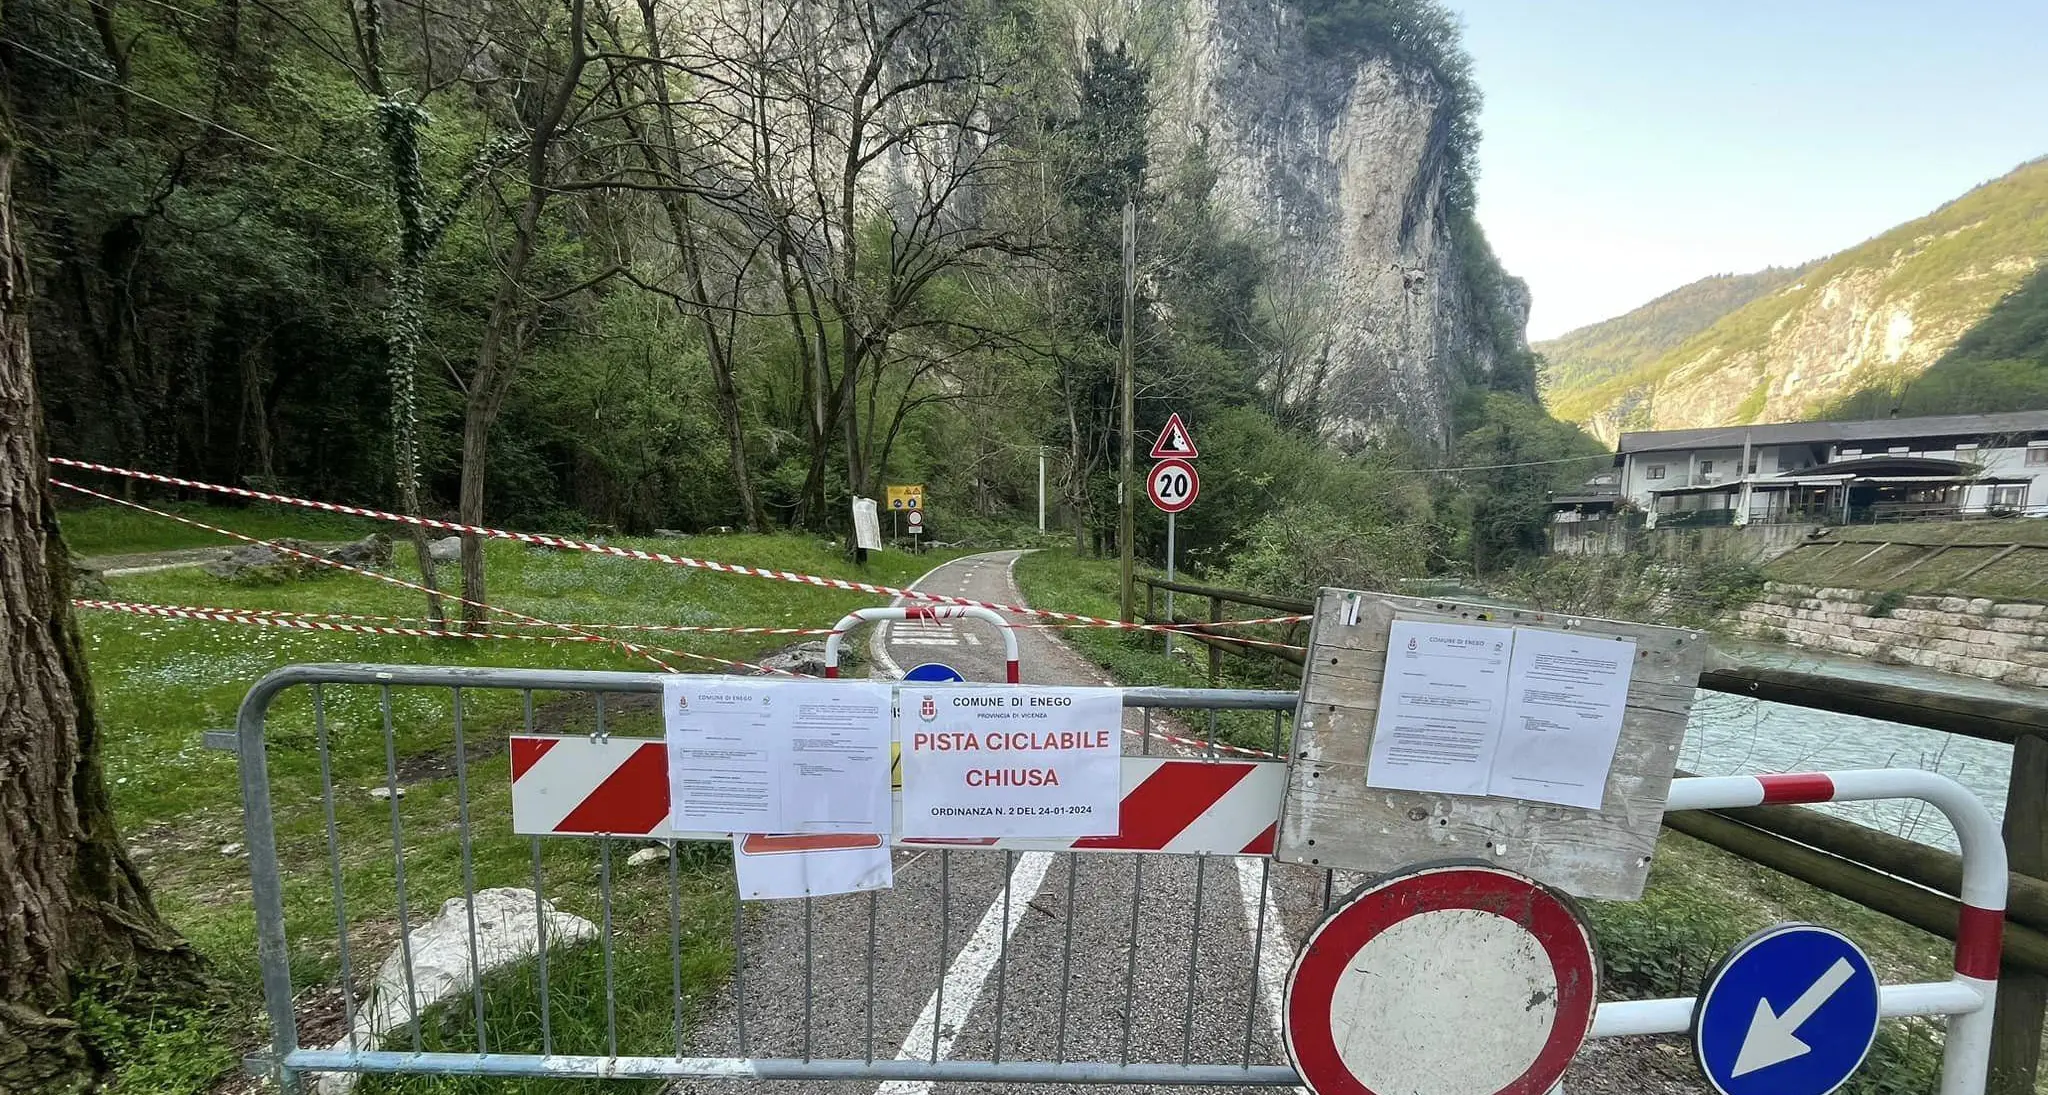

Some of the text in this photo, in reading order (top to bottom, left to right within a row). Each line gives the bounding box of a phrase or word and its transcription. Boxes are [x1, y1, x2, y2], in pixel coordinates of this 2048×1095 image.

[1160, 473, 1188, 498] 20
[698, 694, 723, 702] COMUNE
[725, 694, 732, 702] DI
[953, 697, 1072, 707] COMUNE DI ENEGO
[914, 730, 1110, 751] PISTA CICLABILE
[966, 768, 1060, 787] CHIUSA
[931, 805, 1093, 817] ORDINANZA N. 2 DEL 24-01-2024
